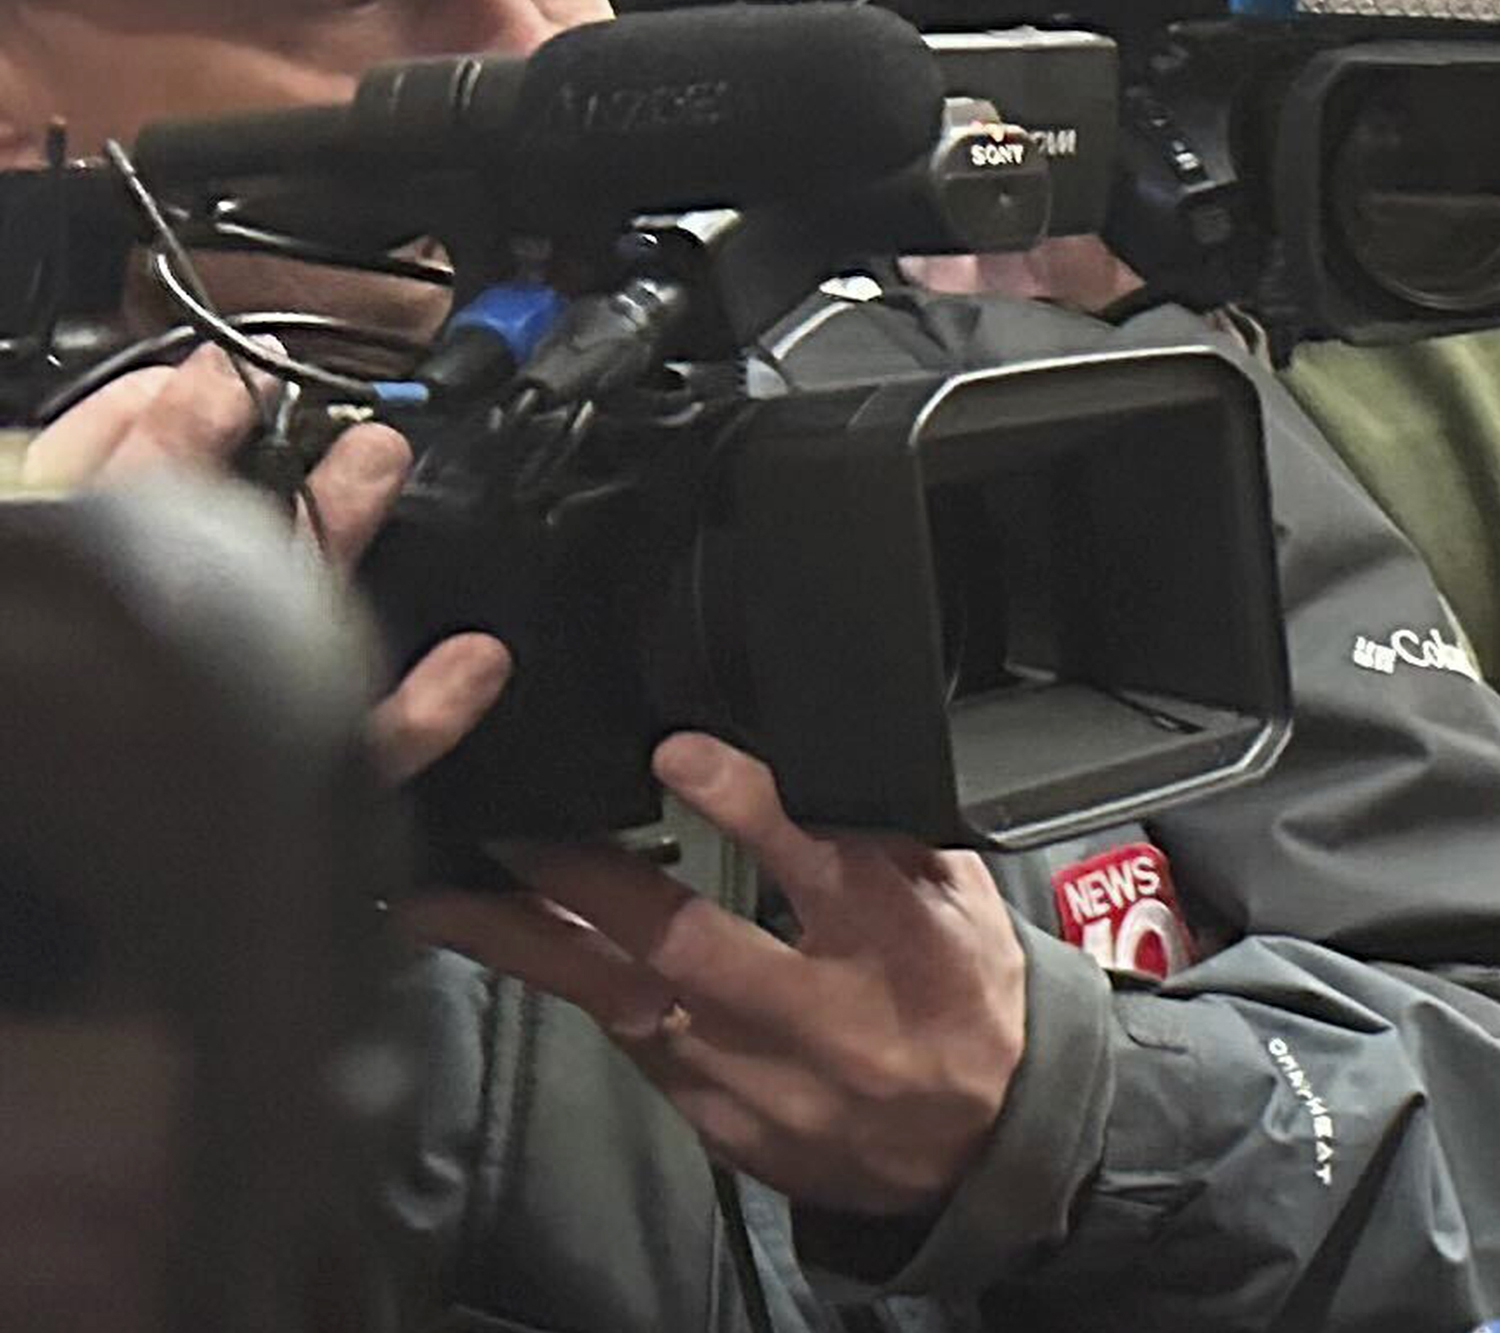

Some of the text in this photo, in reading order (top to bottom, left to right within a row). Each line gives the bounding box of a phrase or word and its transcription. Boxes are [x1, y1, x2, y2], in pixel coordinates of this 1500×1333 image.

[970, 143, 1024, 166] SONY
[1063, 855, 1161, 926] NEWS
[1083, 897, 1187, 982] 10
